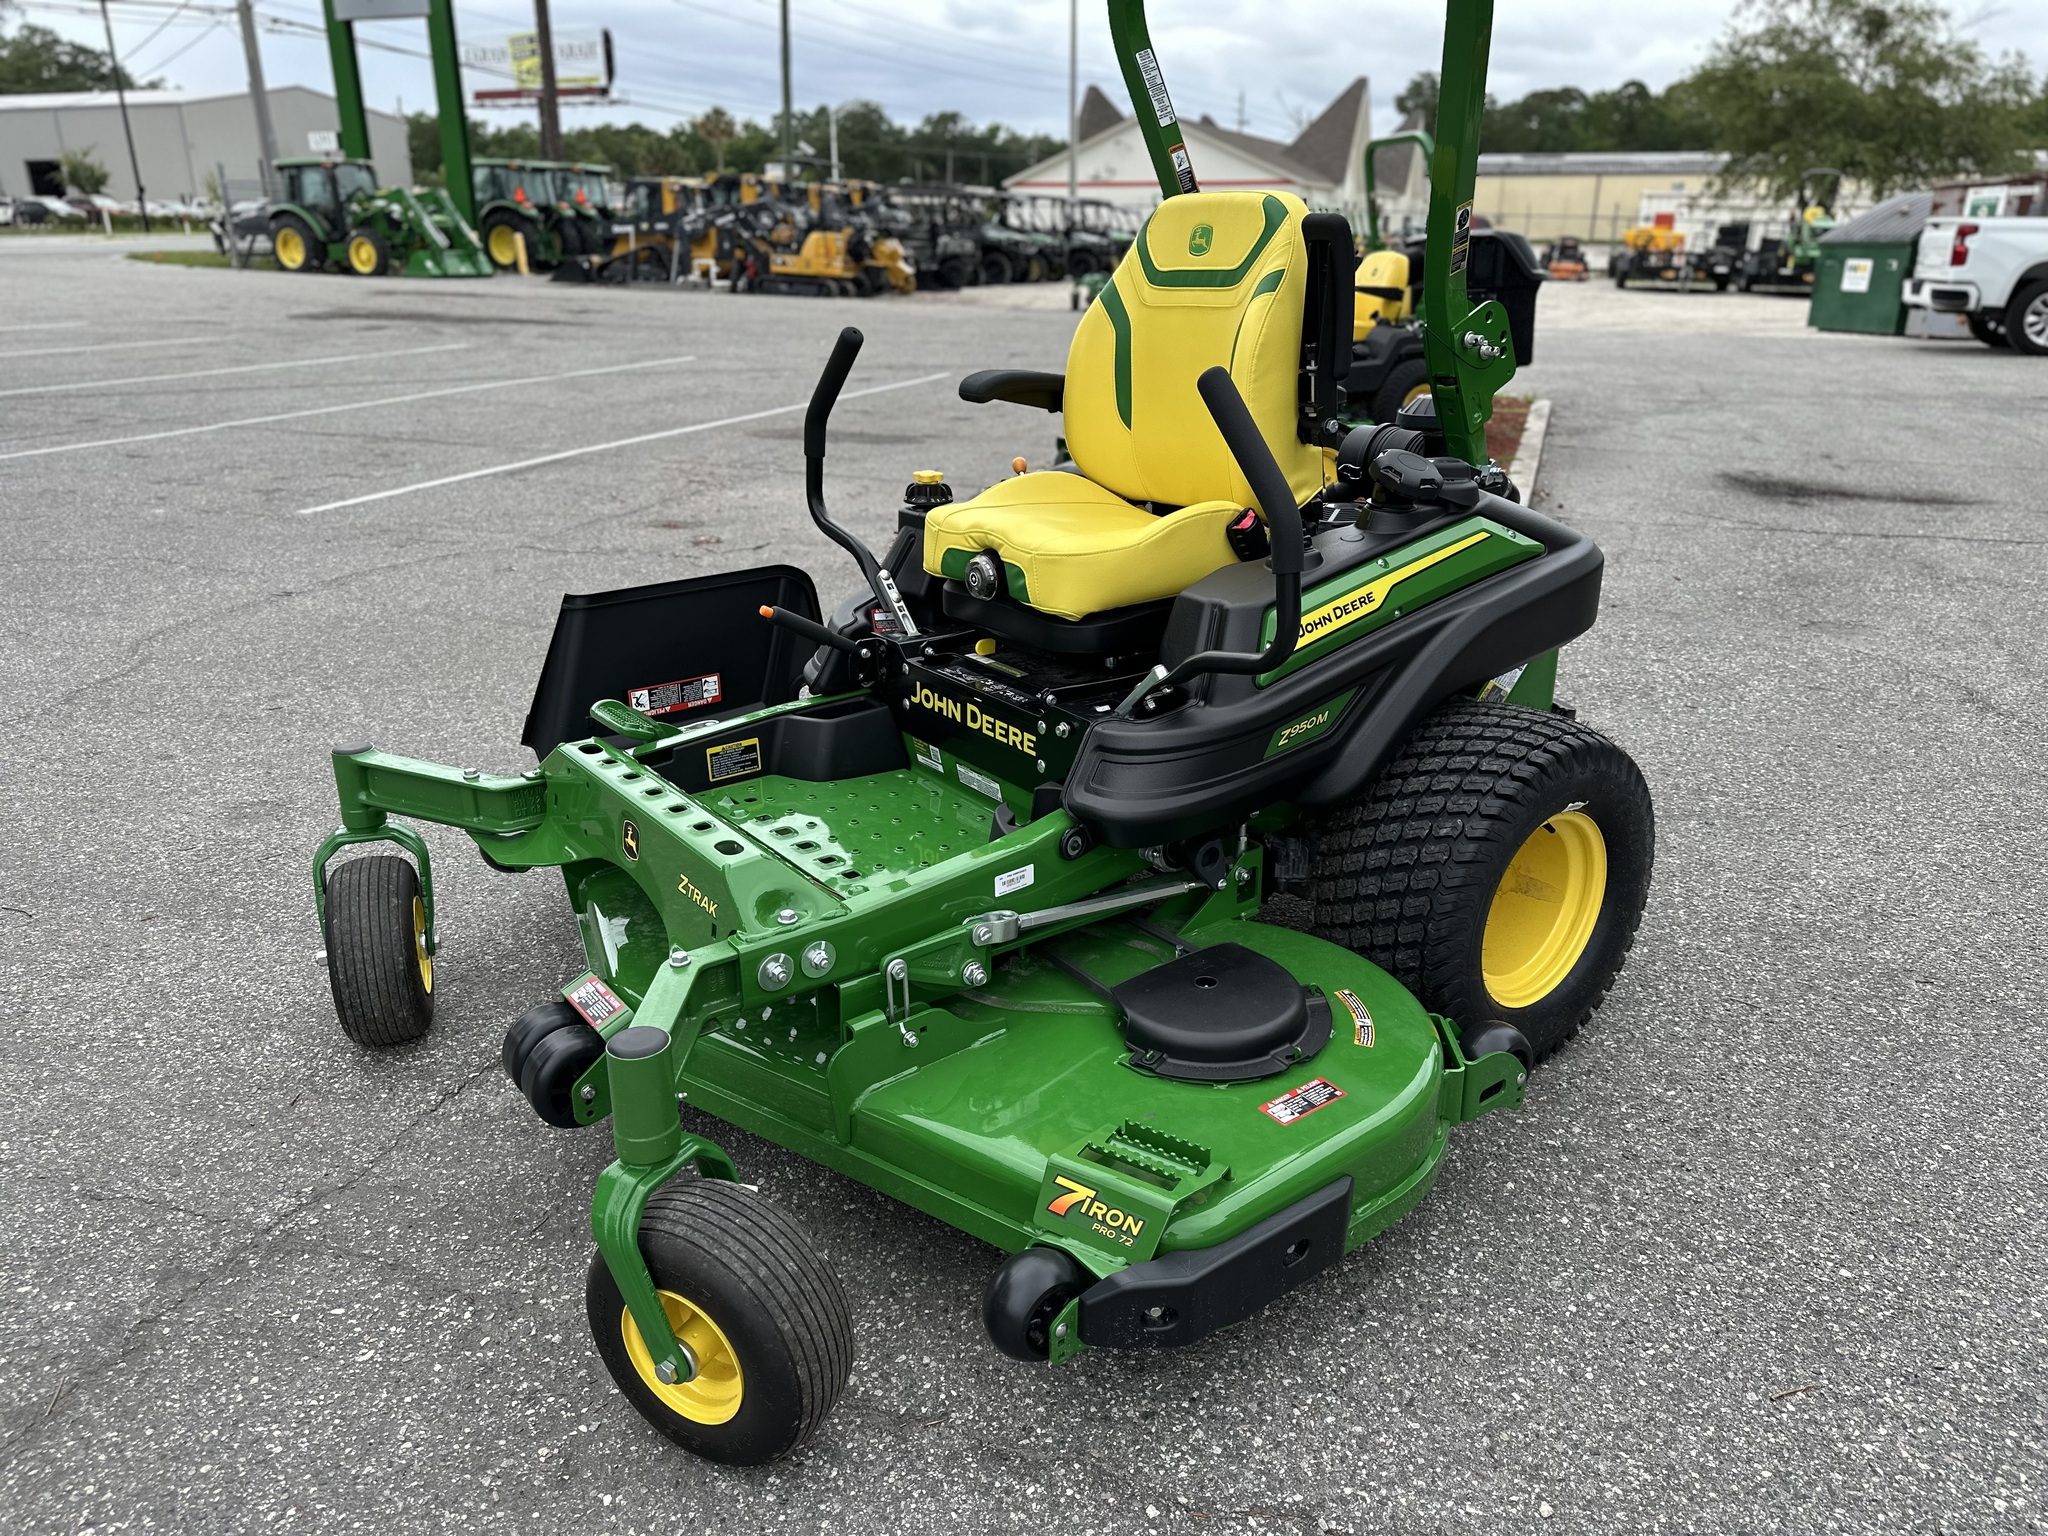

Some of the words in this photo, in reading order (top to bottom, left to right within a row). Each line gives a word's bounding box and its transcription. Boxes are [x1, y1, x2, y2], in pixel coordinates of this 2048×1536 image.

[1299, 613, 1333, 638] JOHN
[1333, 592, 1375, 620] DEERE
[910, 681, 961, 722] JOHN
[966, 703, 1037, 756] DEERE
[1278, 710, 1329, 747] Z950M
[677, 873, 719, 918] ZTRAK
[1091, 1222, 1116, 1239] PRO
[1118, 1234, 1135, 1247] 72
